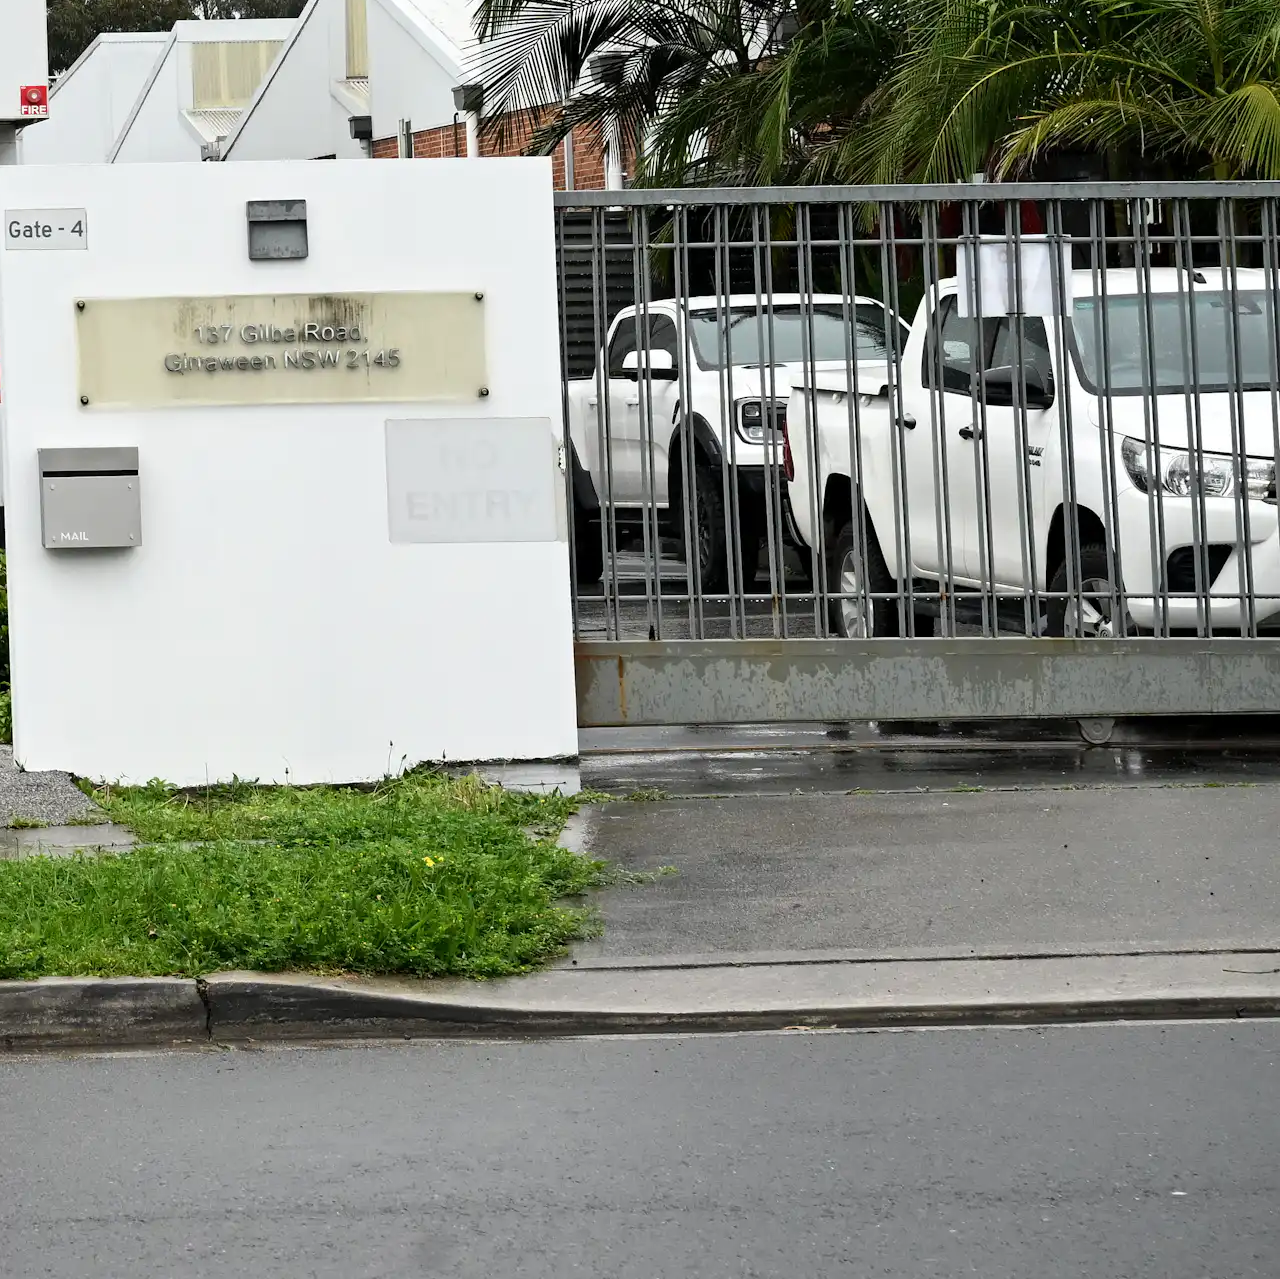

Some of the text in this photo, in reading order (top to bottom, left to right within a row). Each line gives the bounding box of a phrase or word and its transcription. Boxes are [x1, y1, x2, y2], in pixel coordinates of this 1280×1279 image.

[21, 105, 47, 115] FIRE
[9, 220, 52, 238] Gate
[70, 220, 84, 237] 4
[195, 322, 369, 343] 137 Gilba Road,
[164, 348, 401, 374] Girraween NSW 2145
[405, 490, 541, 520] ENTRY
[60, 531, 90, 541] MAIL
